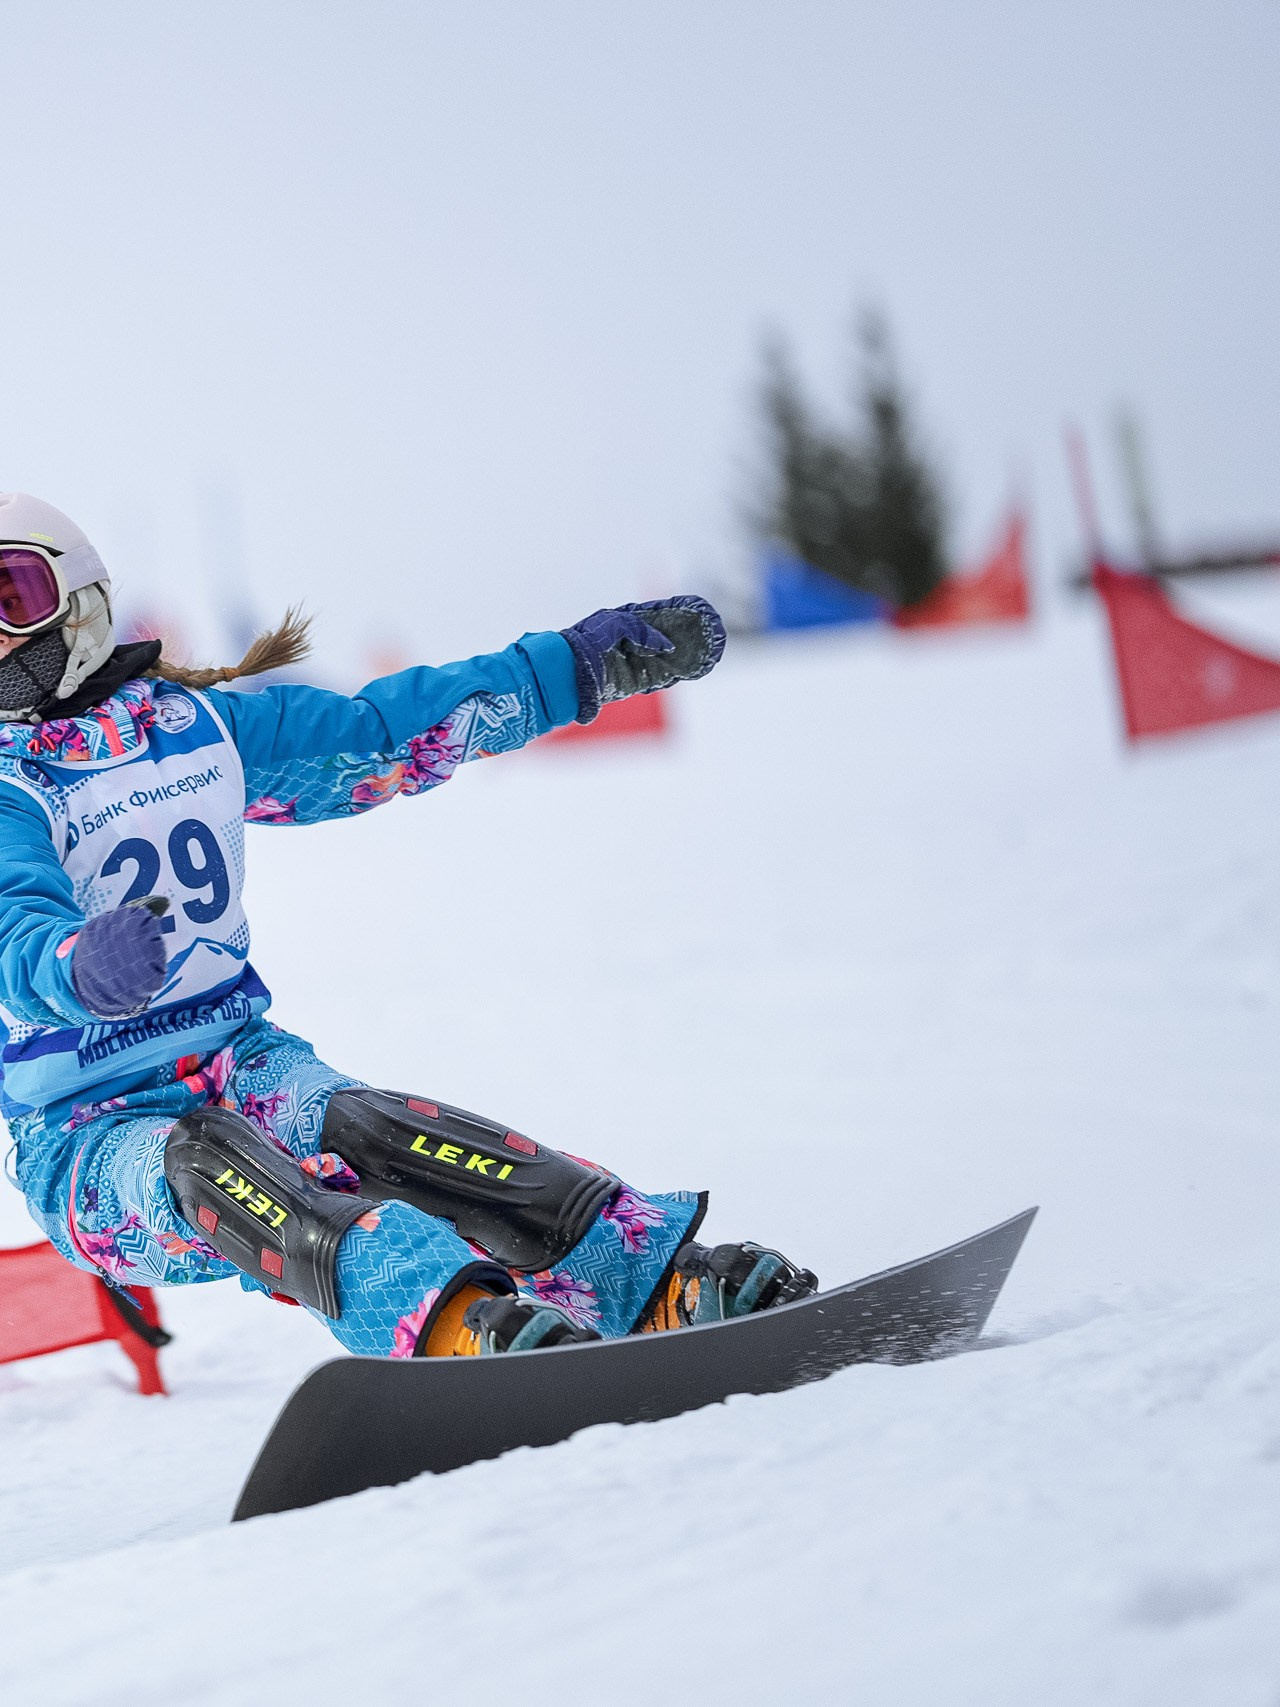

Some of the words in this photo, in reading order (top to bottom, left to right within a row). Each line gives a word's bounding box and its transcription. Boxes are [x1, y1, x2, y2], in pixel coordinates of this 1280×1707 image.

[81, 801, 128, 836] Банк
[100, 818, 230, 934] 29
[410, 1134, 515, 1181] LEKI
[214, 1168, 288, 1228] LEKI
